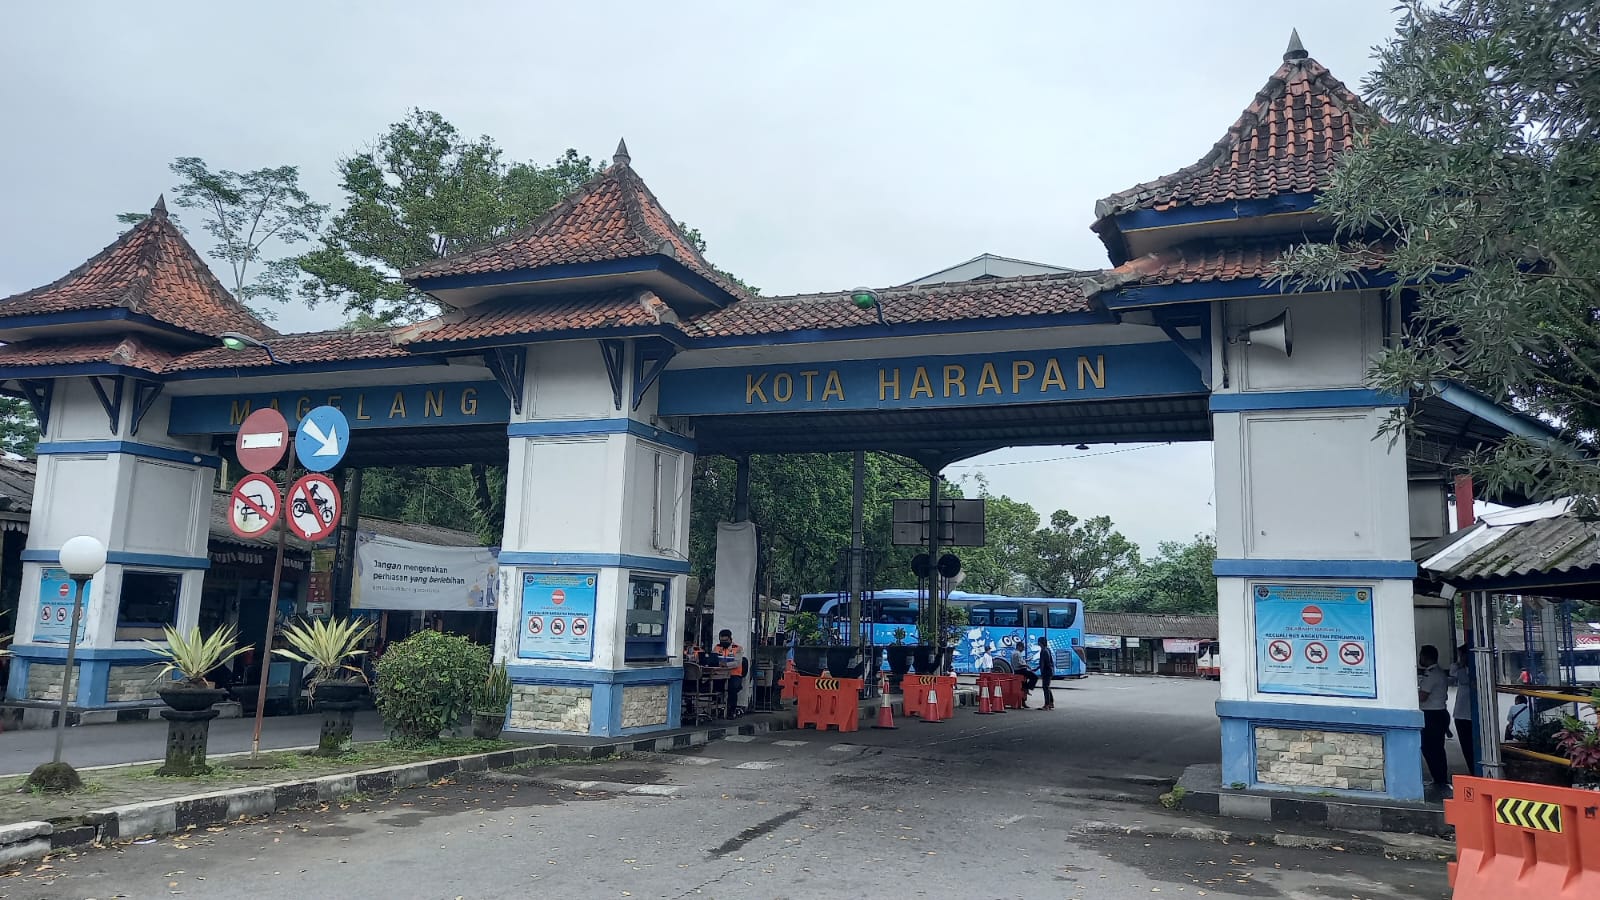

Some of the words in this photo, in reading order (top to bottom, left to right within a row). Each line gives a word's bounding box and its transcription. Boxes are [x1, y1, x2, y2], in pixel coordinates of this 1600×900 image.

[745, 369, 846, 404] KOTA
[878, 354, 1106, 401] HARAPAN
[373, 559, 402, 571] Jangan
[403, 562, 448, 574] mengenakan
[372, 571, 408, 583] perhiasan
[409, 575, 428, 584] yang
[428, 573, 465, 585] berlebihan
